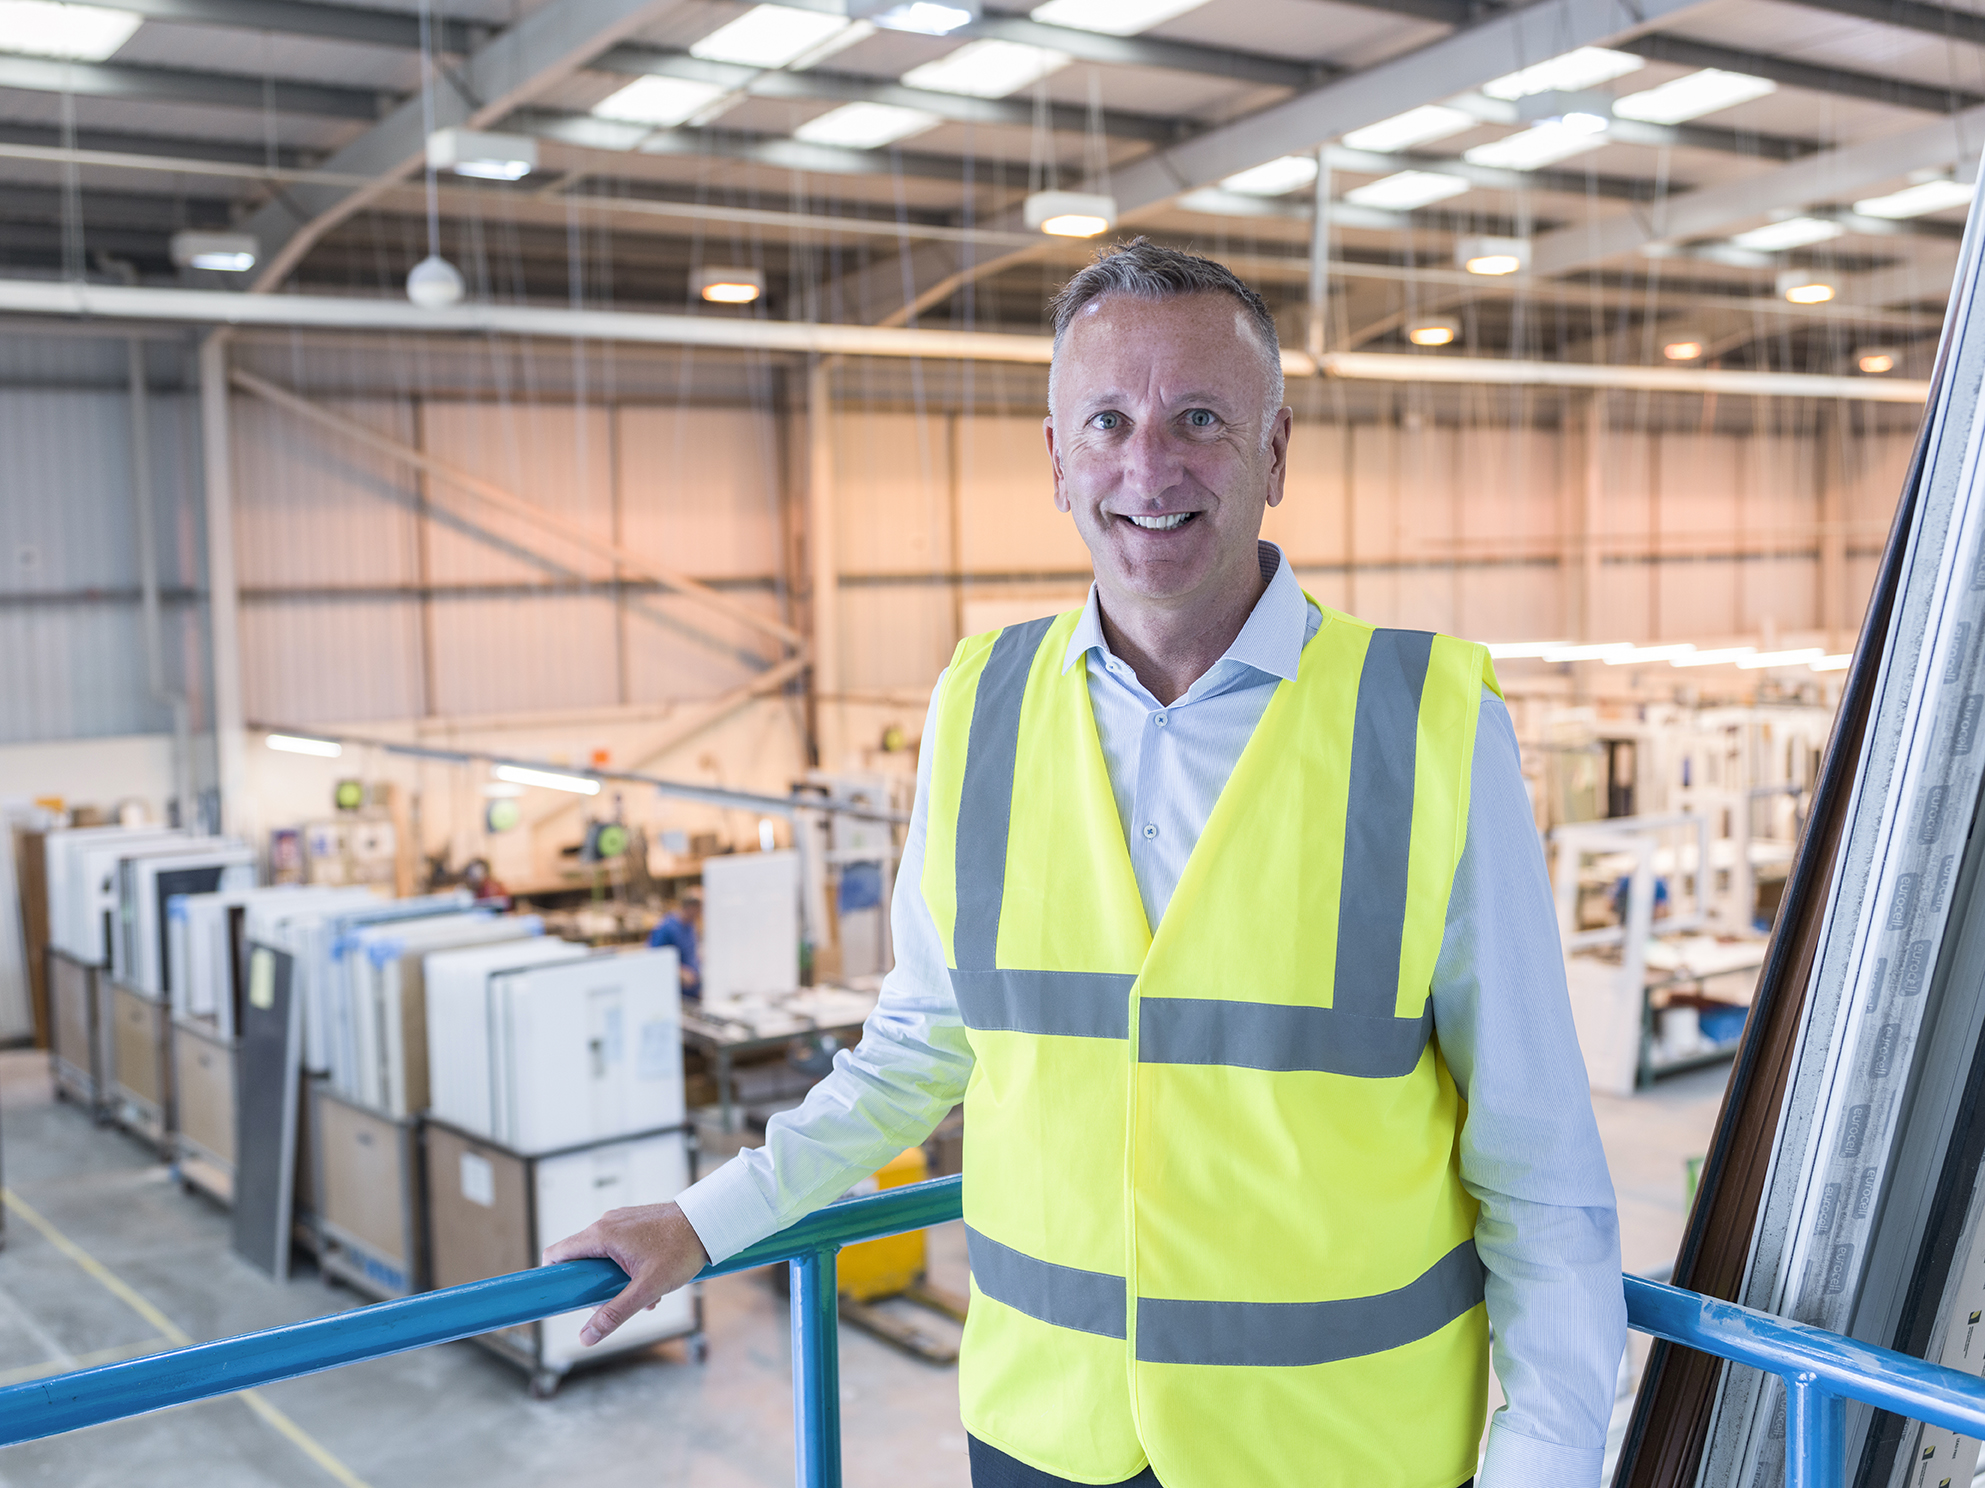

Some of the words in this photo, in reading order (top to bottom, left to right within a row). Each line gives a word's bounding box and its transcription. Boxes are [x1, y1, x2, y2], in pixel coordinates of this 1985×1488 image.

[1956, 698, 1975, 751] eurocell
[1923, 788, 1943, 840] eurocell
[1892, 876, 1911, 927] eurocell
[1905, 943, 1924, 992] eurocell
[1875, 1026, 1893, 1075] eurocell
[1845, 1107, 1863, 1154] eurocell
[1816, 1186, 1833, 1231] eurocell
[1858, 1169, 1876, 1215] eurocell
[1829, 1246, 1846, 1291] eurocell
